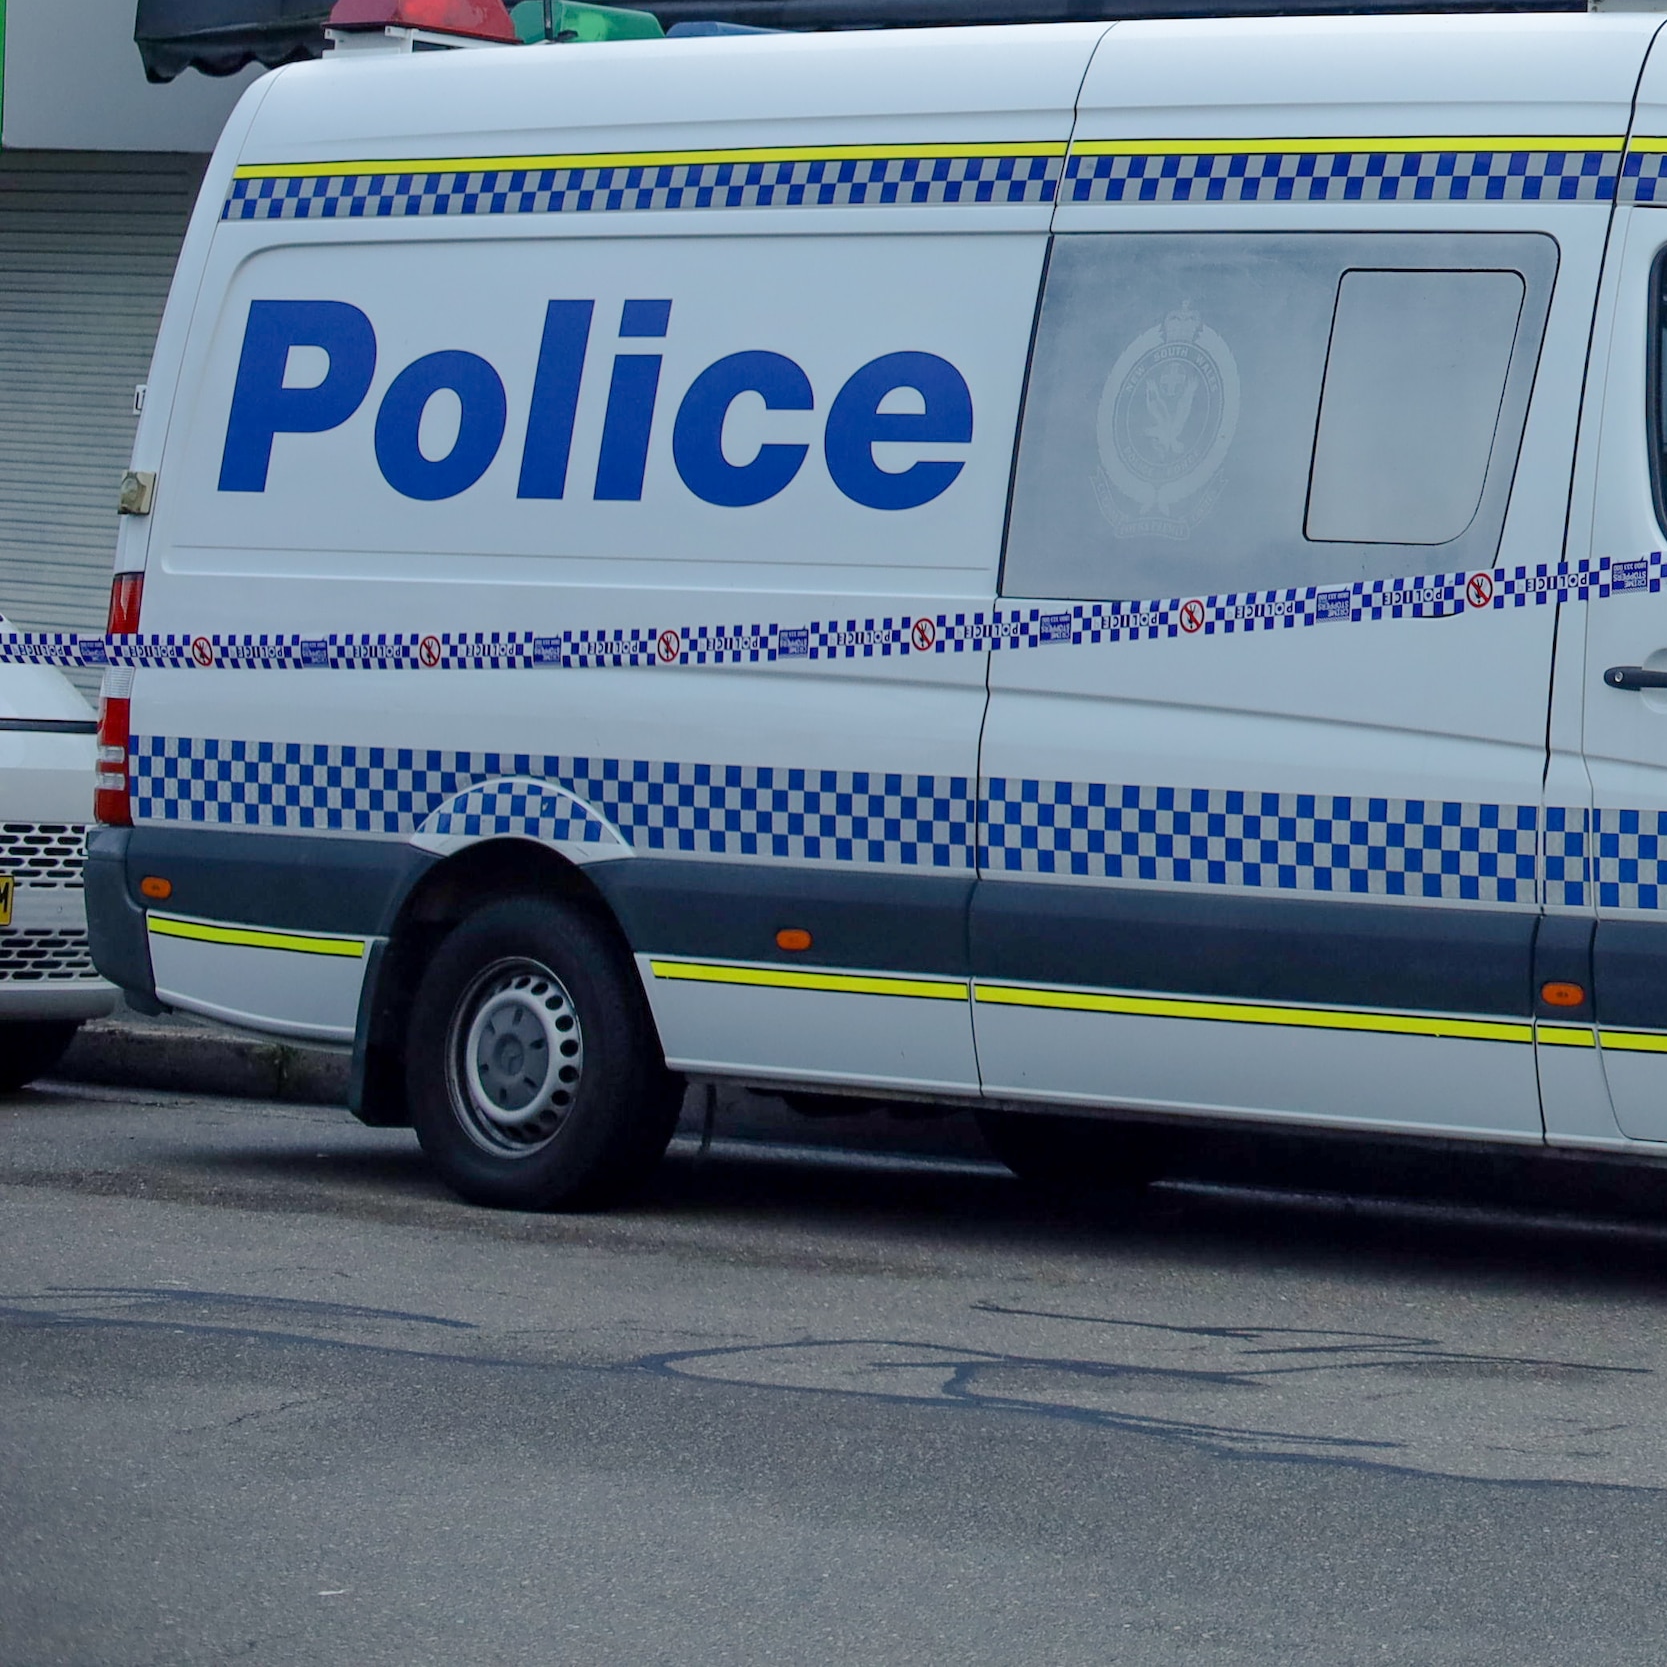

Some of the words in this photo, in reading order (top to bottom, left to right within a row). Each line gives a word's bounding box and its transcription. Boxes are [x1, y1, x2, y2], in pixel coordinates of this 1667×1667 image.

[1153, 346, 1189, 362] SOUTH
[217, 299, 974, 511] Police
[1526, 574, 1588, 592] POLICE
[1613, 571, 1646, 581] STOPPERS
[1383, 588, 1443, 605] POLICE
[1235, 603, 1294, 619] POLICE
[1102, 614, 1158, 630] POLICE
[838, 632, 890, 645] POLICE
[964, 624, 1018, 638] POLICE
[588, 642, 638, 654] POLICE
[707, 638, 758, 650] POLICE
